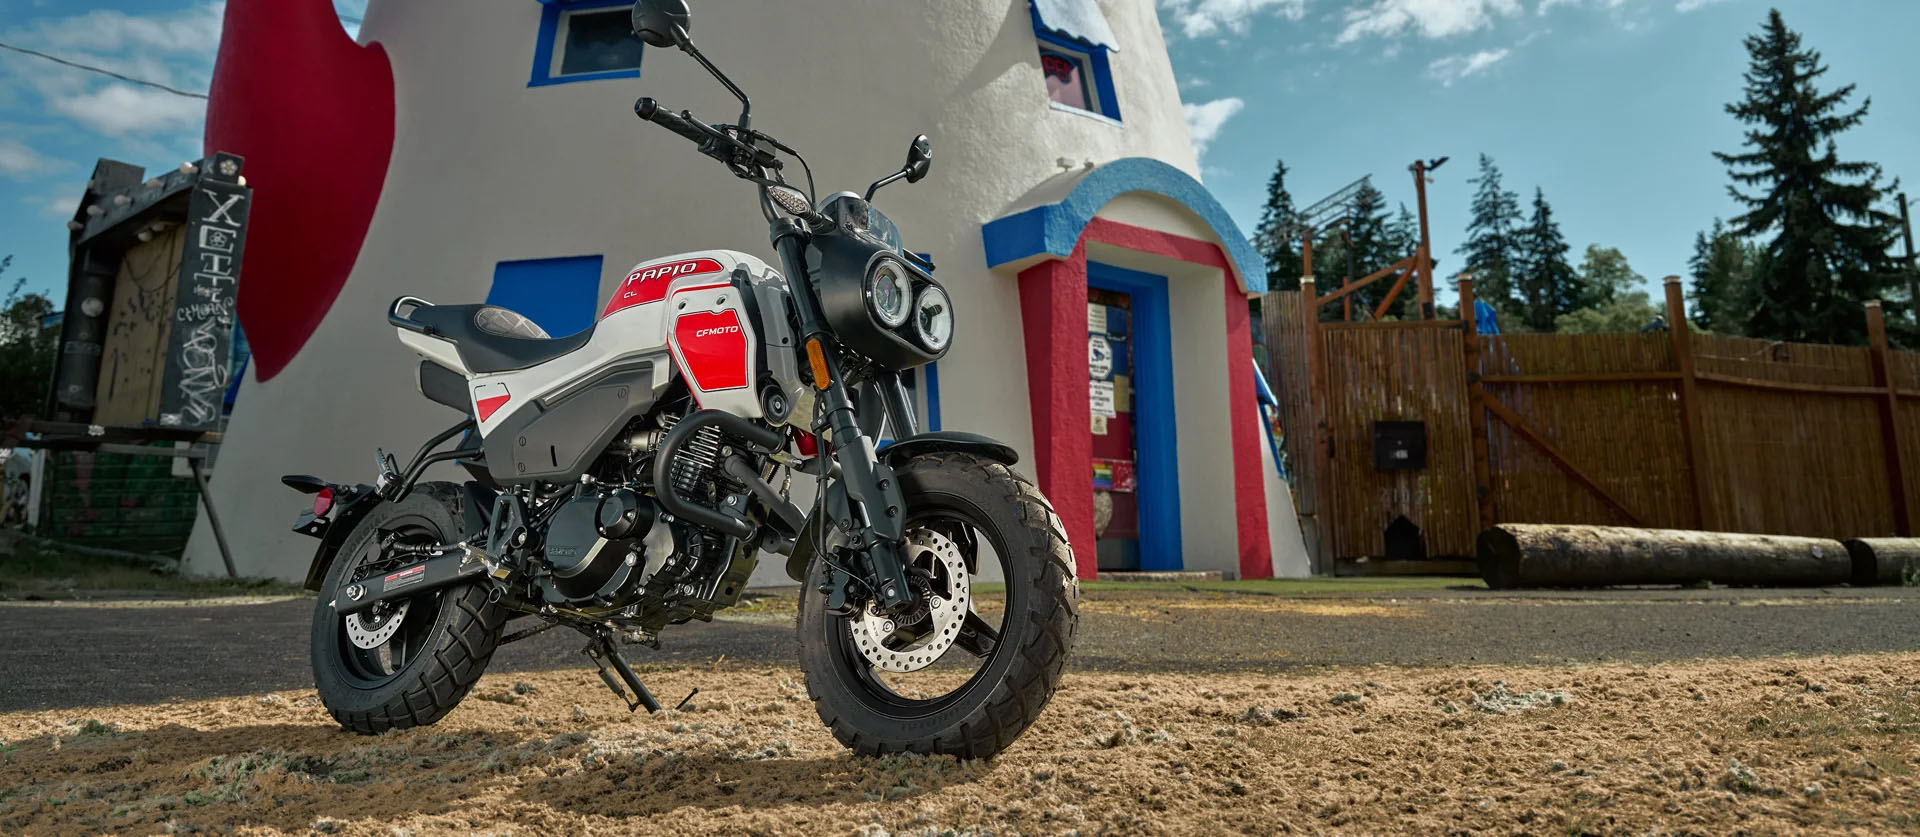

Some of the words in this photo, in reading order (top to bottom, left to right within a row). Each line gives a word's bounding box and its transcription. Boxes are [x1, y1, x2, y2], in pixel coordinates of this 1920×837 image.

[627, 262, 697, 286] PAPIO
[623, 291, 637, 299] CL
[696, 326, 738, 338] CFMOTO
